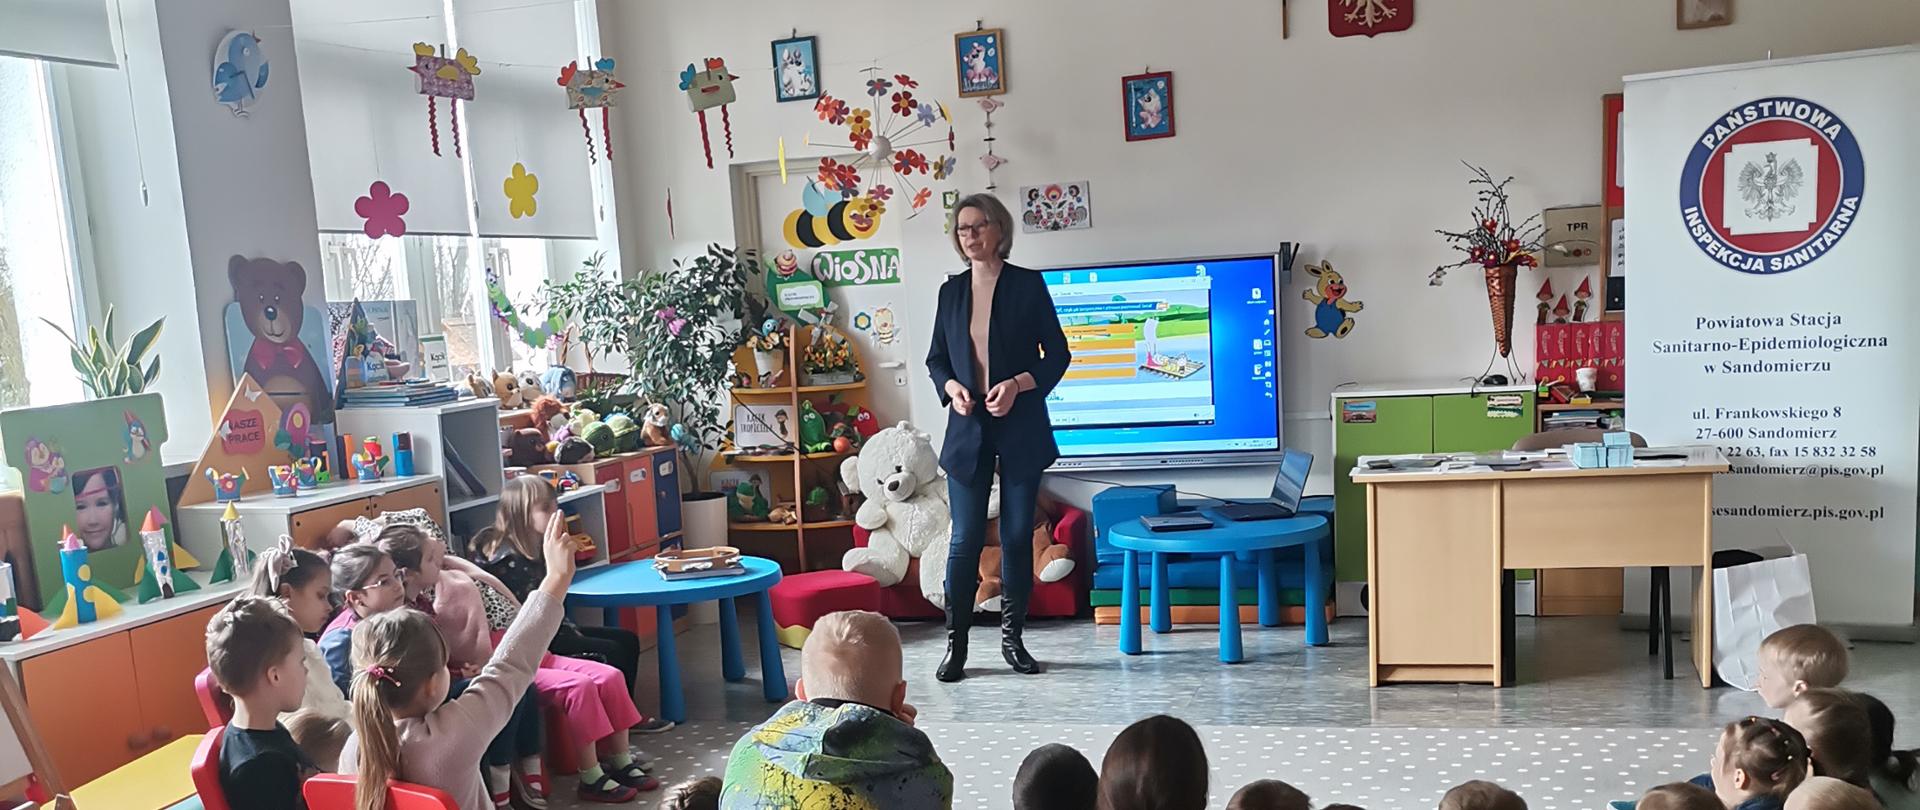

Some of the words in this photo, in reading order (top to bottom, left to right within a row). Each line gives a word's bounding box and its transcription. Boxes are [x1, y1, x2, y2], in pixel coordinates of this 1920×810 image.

[1701, 101, 1842, 150] PAŃSTWOWA
[1566, 222, 1588, 231] TPR
[1684, 206, 1765, 272] INSPEKCJA
[1770, 196, 1859, 272] SANITARNA
[1695, 315, 1784, 330] Powiatowa
[1790, 312, 1842, 329] Stacja
[1652, 334, 1888, 354] Sanitarno-Epidemiologiczna
[1703, 363, 1716, 374] w
[1722, 358, 1831, 374] Sandomierzu
[1692, 408, 1710, 420] ul.
[1715, 406, 1828, 421] Frankowskiego
[1833, 406, 1842, 418] 8
[1695, 427, 1743, 440] 27-600
[1748, 426, 1838, 439] Sandomierz
[1727, 446, 1742, 458] 22
[1746, 446, 1765, 458] 63,
[1769, 446, 1789, 457] fax
[1794, 446, 1809, 457] 15
[1812, 446, 1836, 457] 832
[1840, 446, 1856, 457] 32
[1860, 446, 1877, 457] 58
